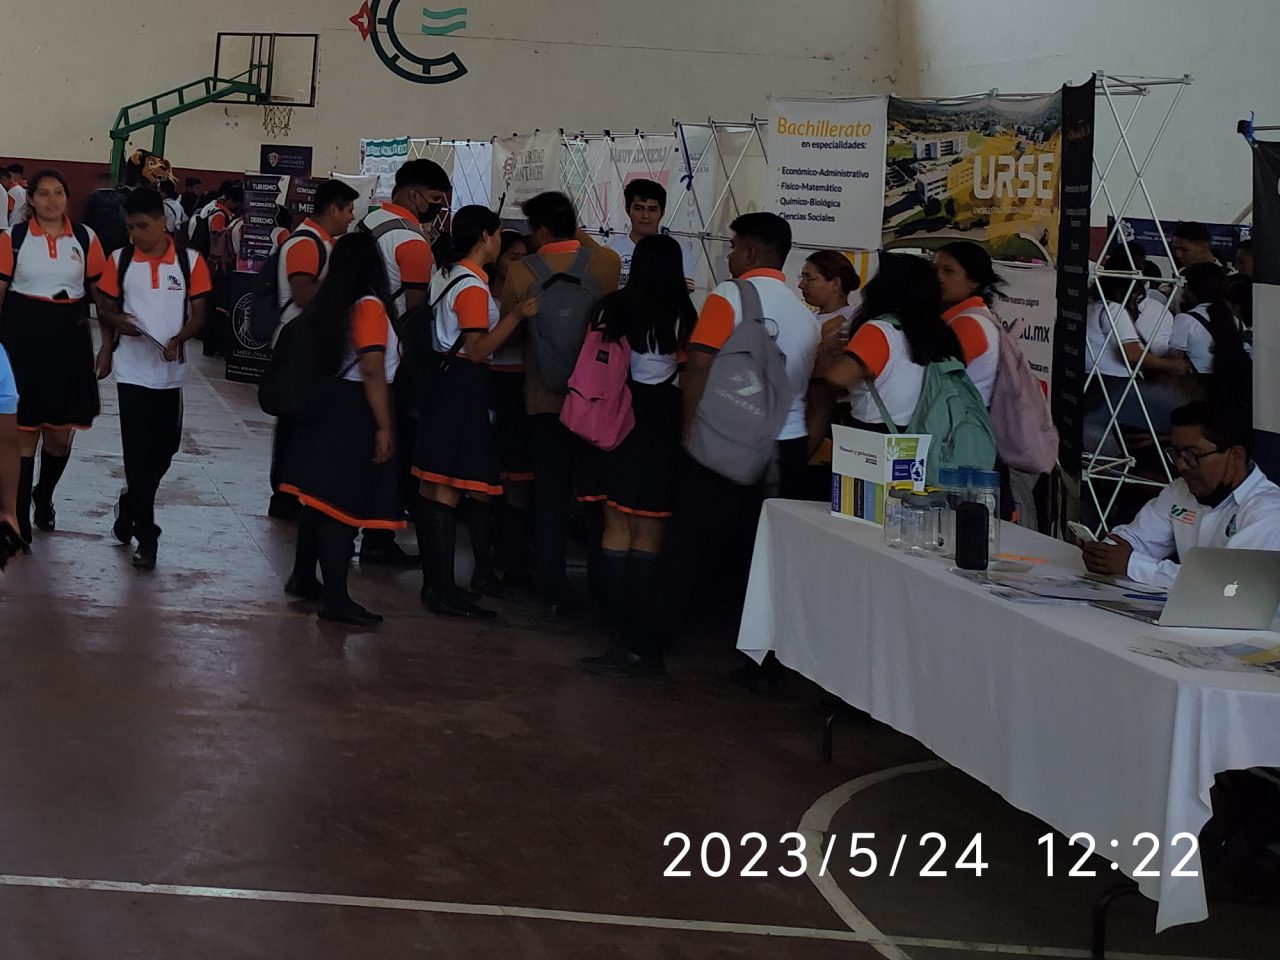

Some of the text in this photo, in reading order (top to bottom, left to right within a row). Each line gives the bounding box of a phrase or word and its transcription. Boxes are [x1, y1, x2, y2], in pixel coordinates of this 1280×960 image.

[776, 116, 872, 138] Bachillerato
[801, 140, 867, 150] en especialidades:
[781, 166, 870, 179] Económico-Administrativo
[973, 152, 1055, 200] URSE
[252, 183, 277, 191] TURISMO
[780, 181, 843, 193] Físico-Matemático
[780, 197, 841, 209] Químico-Biológica
[250, 216, 274, 225] DERECHO
[807, 212, 836, 223] Sociales
